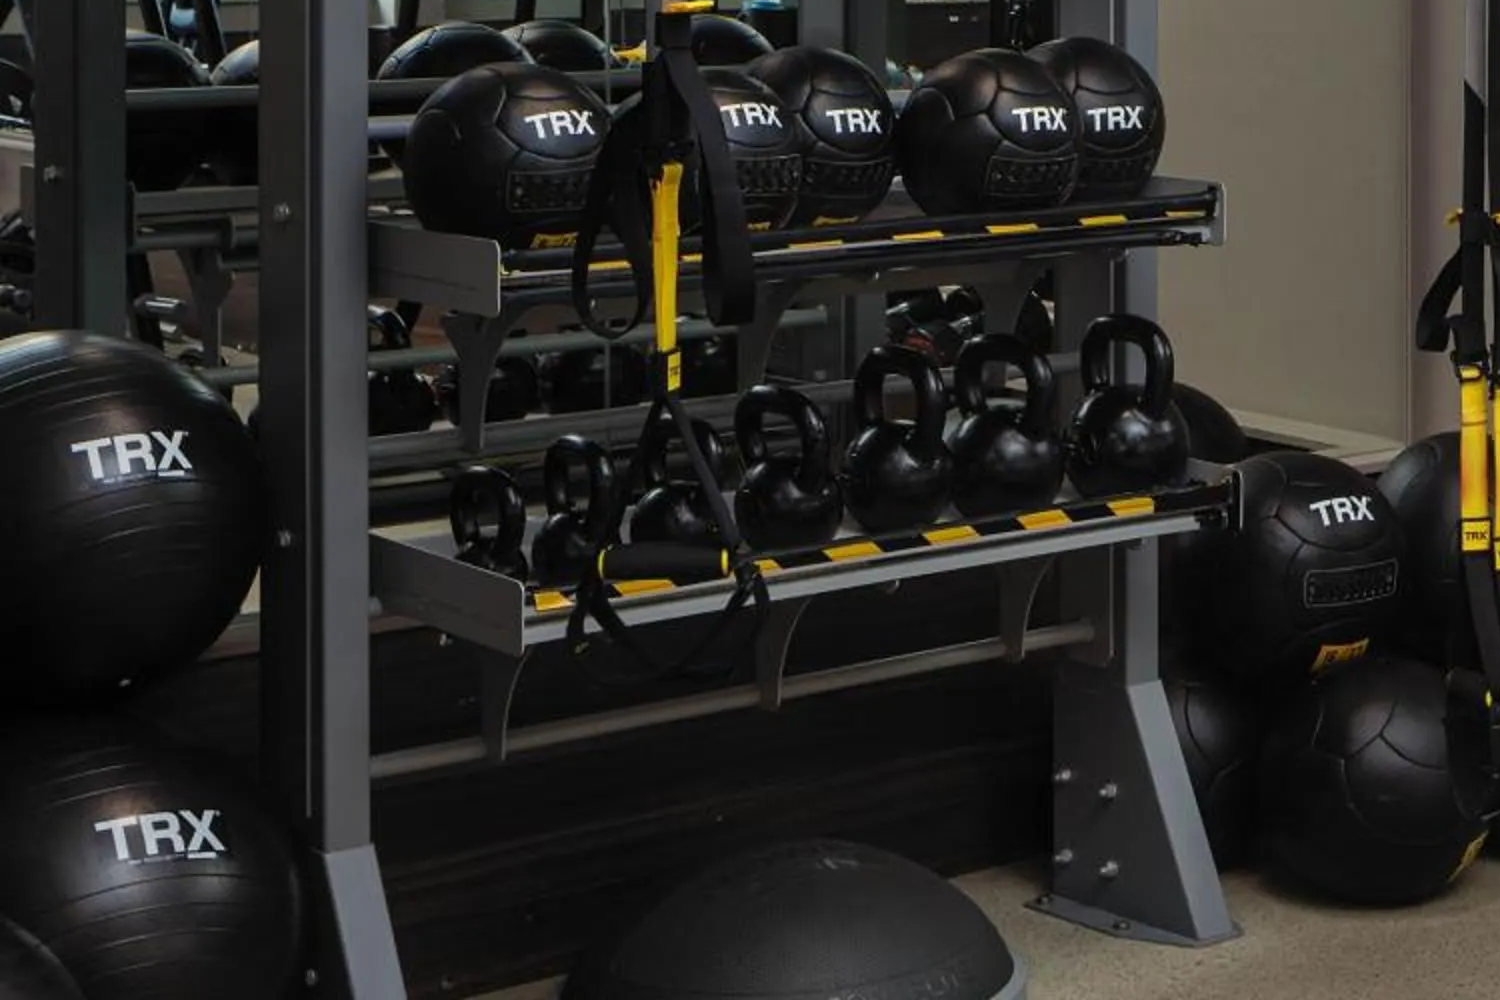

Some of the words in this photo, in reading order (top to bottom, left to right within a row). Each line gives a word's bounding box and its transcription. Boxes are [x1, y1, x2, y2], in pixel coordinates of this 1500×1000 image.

[524, 110, 595, 139] TRX
[719, 102, 783, 129] TRX
[825, 108, 881, 133] TRX
[1011, 106, 1067, 132] TRX
[1087, 105, 1142, 132] TRX
[71, 431, 192, 478] TRX
[1309, 495, 1374, 527] TRX
[1465, 531, 1489, 542] TRX
[94, 810, 225, 862] TRX
